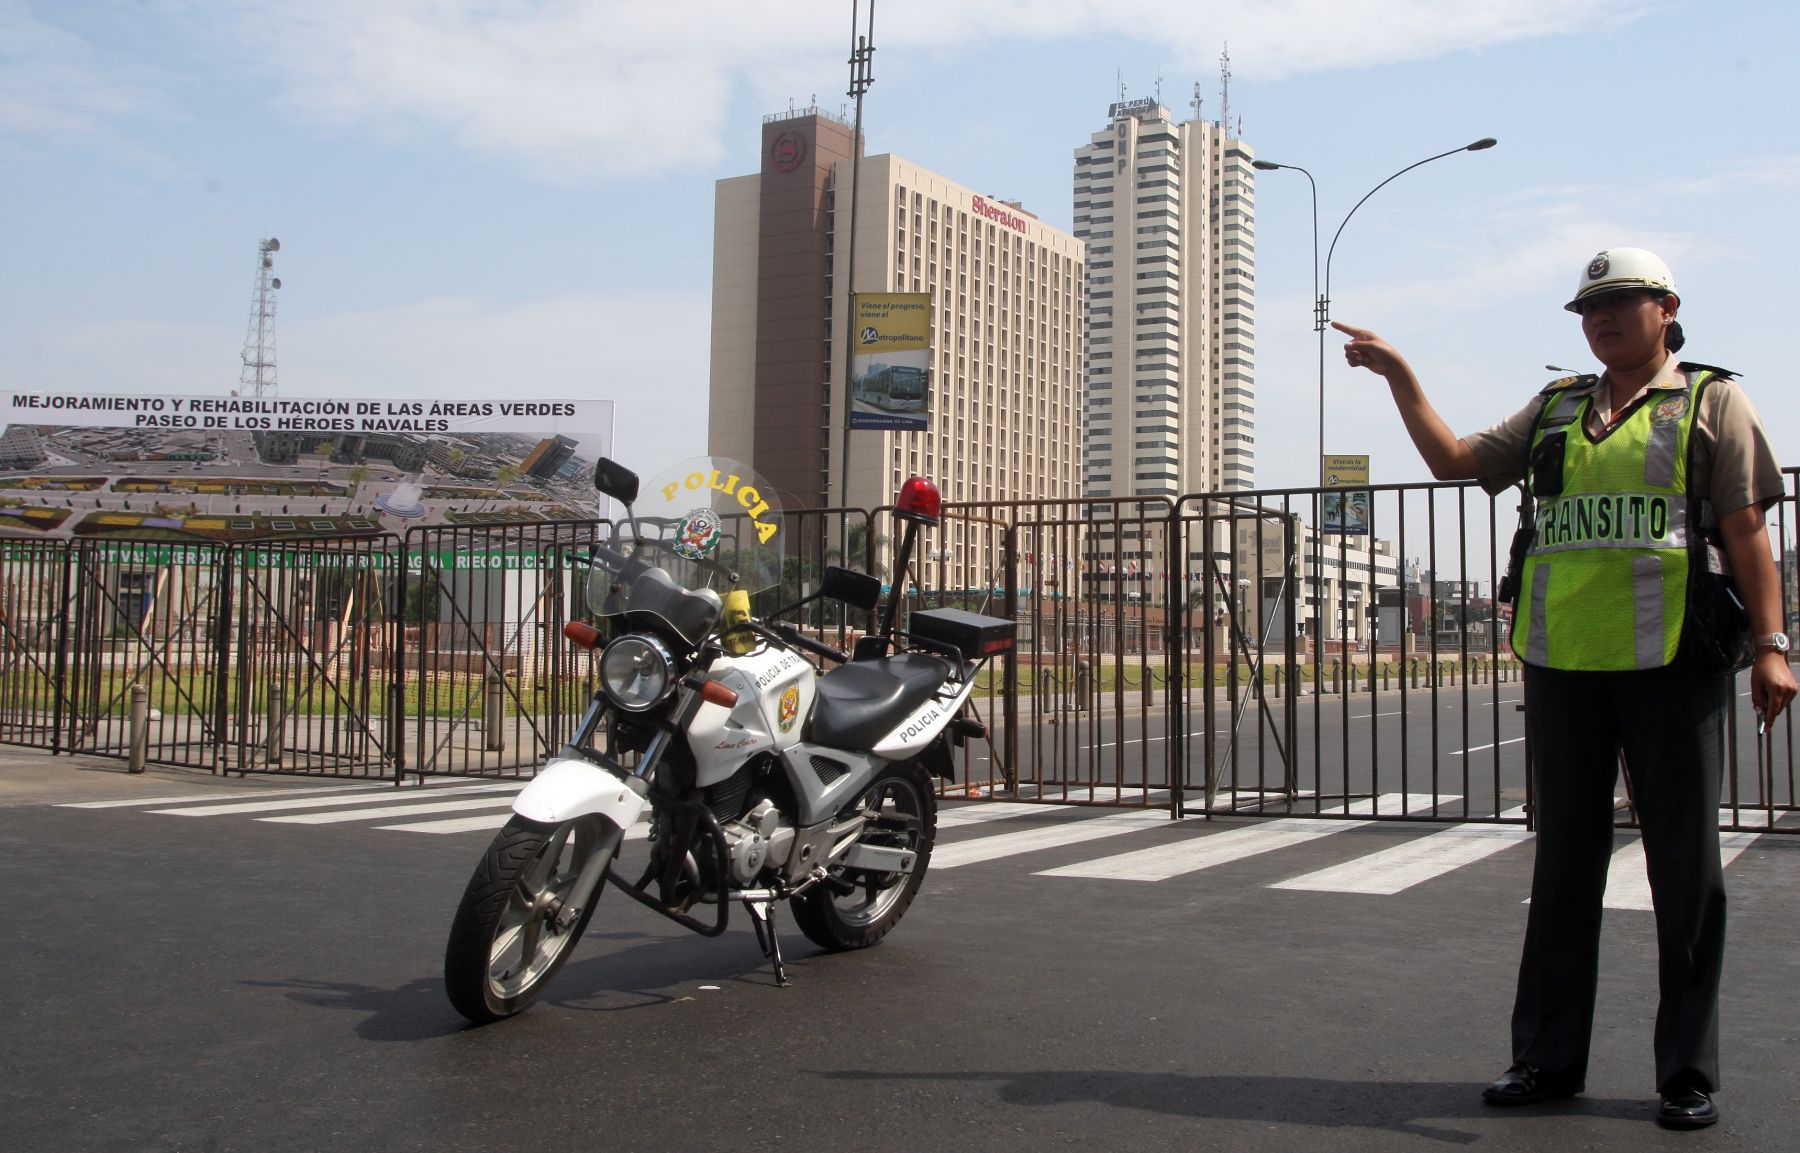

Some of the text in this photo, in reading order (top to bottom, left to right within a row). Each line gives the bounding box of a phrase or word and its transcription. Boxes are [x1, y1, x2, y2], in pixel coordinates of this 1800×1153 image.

[972, 195, 1026, 234] Sheraton
[861, 302, 882, 310] Viene
[890, 303, 925, 311] progreso,
[12, 395, 576, 417] MEJORAMIENTO Y REHABILITACIÓN DE LAS ÁREAS VERDES
[135, 414, 449, 431] PASEO DE LOS HÉROES NAVALES
[661, 469, 777, 545] POLICIA
[456, 555, 502, 569] RIEGO
[755, 665, 781, 691] POLICIA
[780, 658, 791, 670] DE
[899, 709, 940, 744] POLICIA
